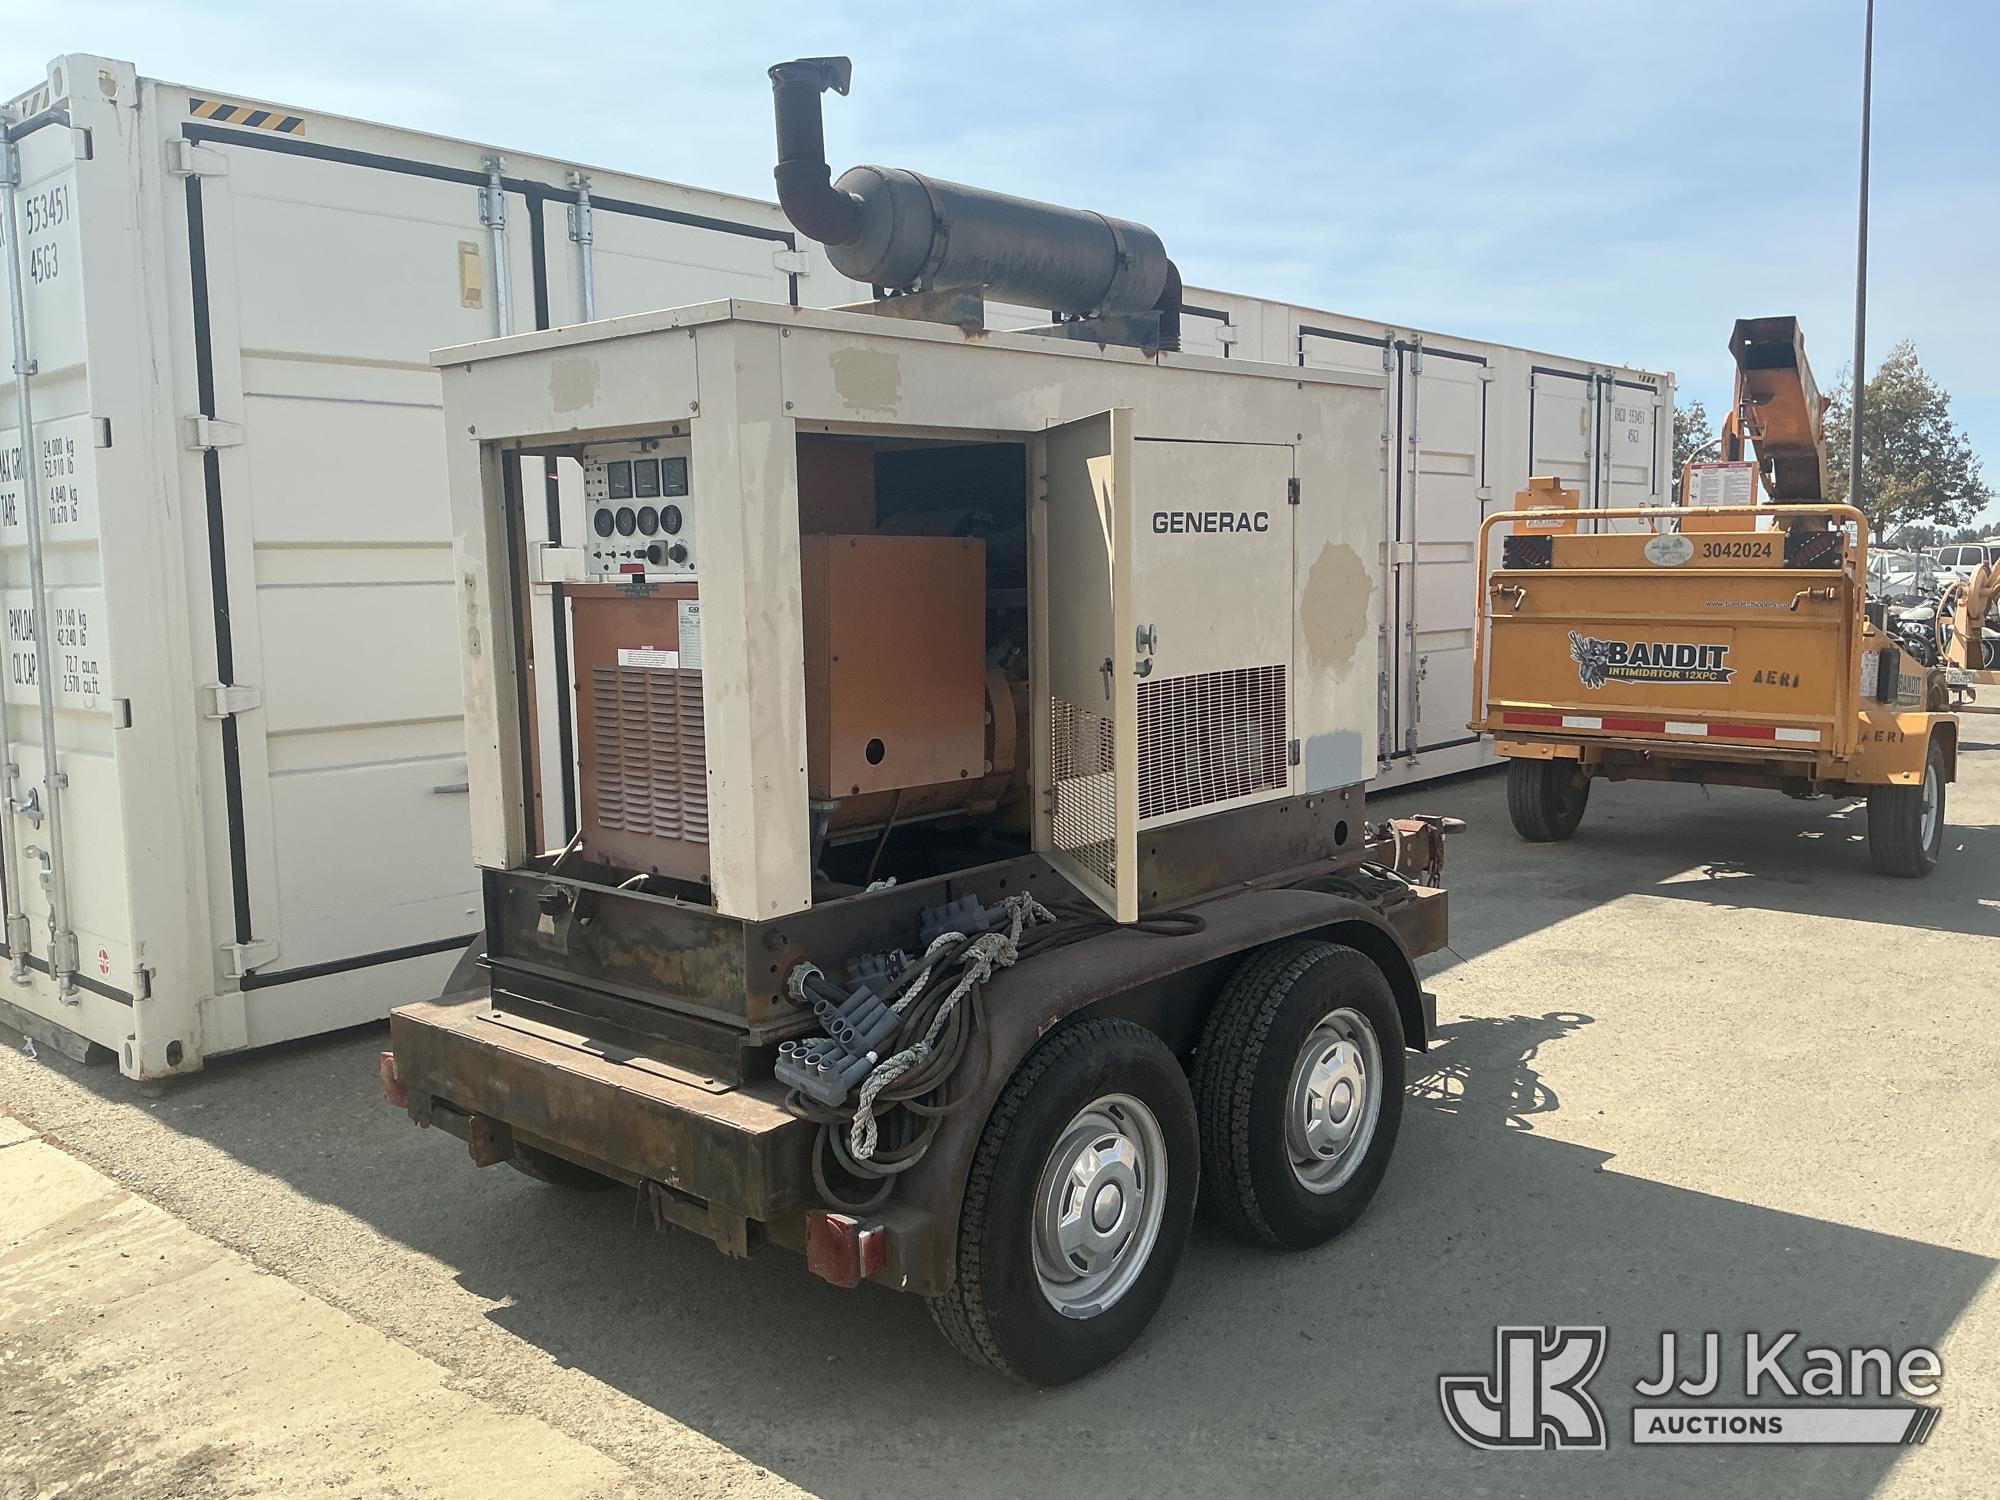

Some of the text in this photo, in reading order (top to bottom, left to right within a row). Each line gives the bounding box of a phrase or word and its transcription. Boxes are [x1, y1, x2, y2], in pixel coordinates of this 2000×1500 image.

[26, 184, 70, 235] 553451
[31, 242, 59, 285] 45G3
[65, 435, 75, 458] kg
[67, 457, 74, 475] lb
[69, 483, 78, 506] kg
[0, 493, 18, 527] TARE
[71, 504, 78, 522] lb
[1152, 511, 1269, 534] GENERAC
[1703, 542, 1772, 558] 3042024
[9, 608, 36, 641] PAYLOA
[78, 608, 87, 631] kg
[80, 628, 87, 646] lb
[65, 654, 78, 673] 72.7
[1607, 641, 1729, 670] BANDIT
[1608, 666, 1717, 680] INTIMIDATOR 12XPC
